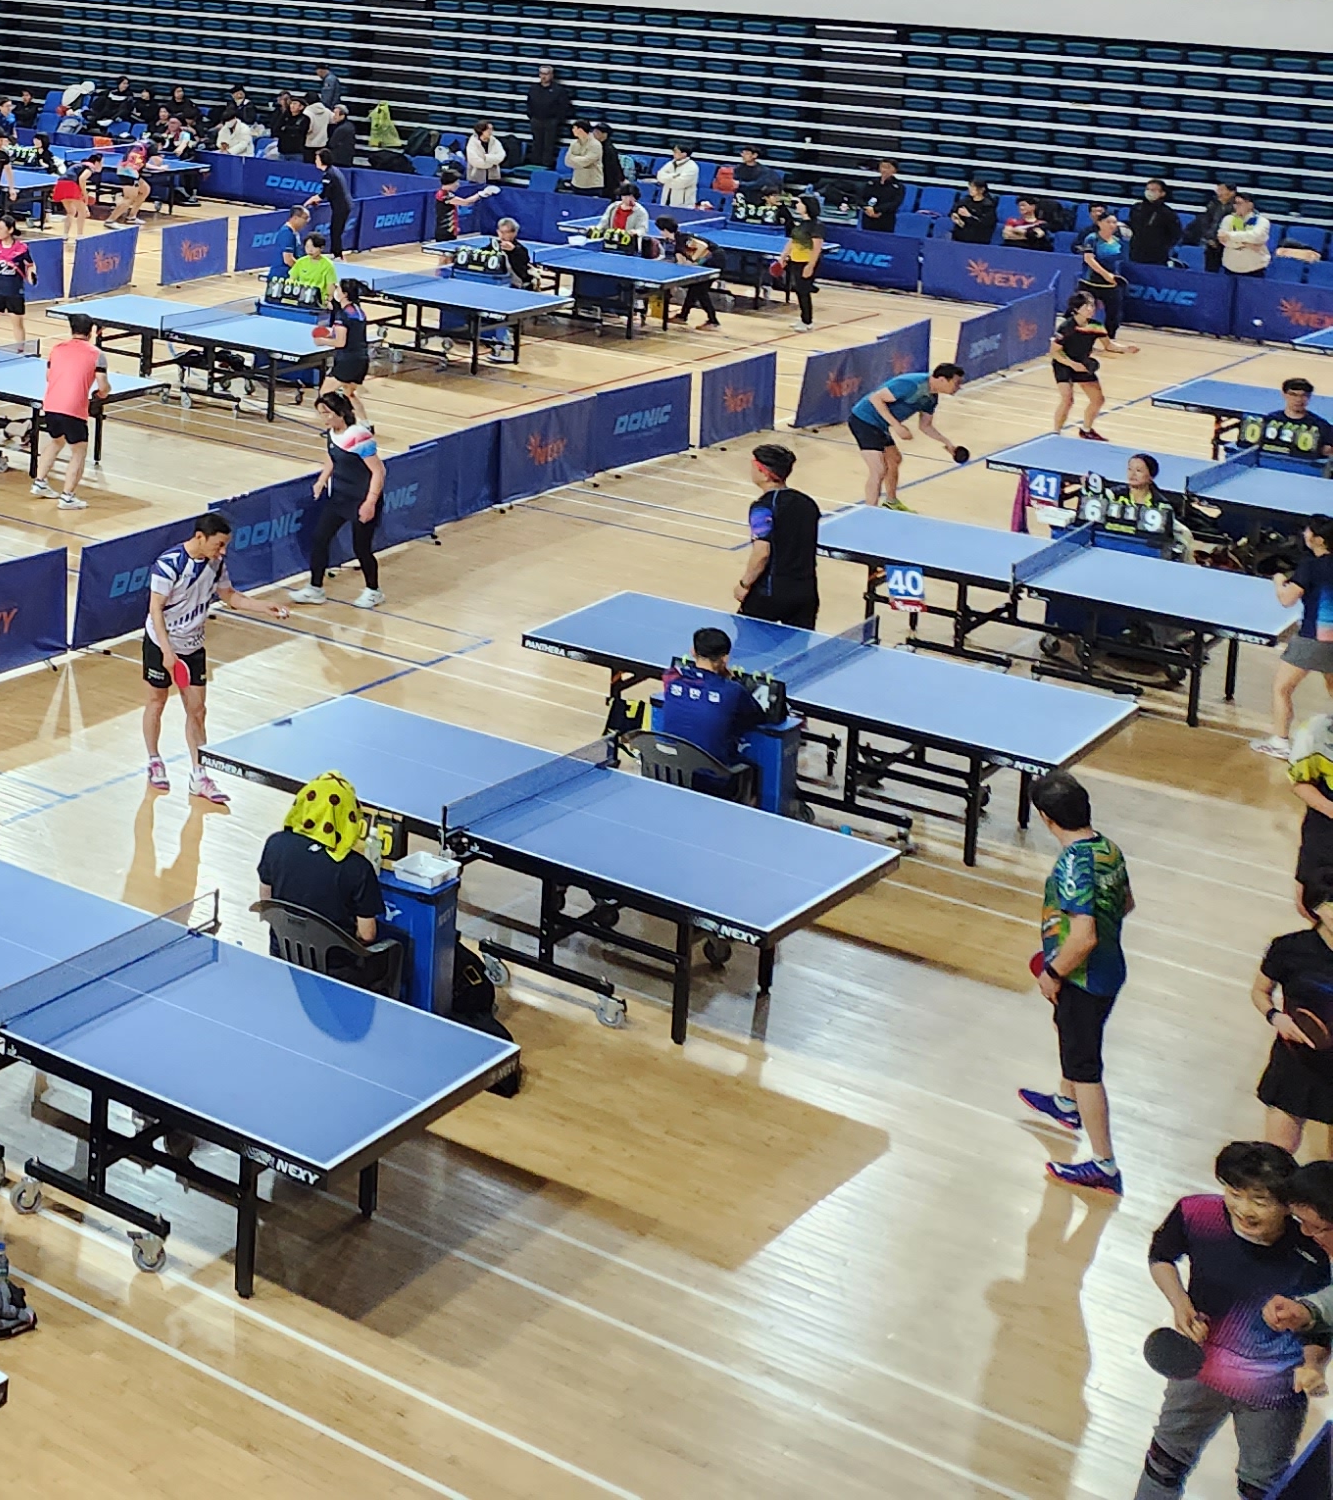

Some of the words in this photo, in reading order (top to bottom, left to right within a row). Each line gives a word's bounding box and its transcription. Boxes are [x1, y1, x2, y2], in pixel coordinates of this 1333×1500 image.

[374, 211, 415, 229] DONIC
[823, 248, 894, 268] ONIC
[977, 271, 1035, 289] NEXY
[613, 404, 672, 435] DONIC
[1028, 474, 1058, 498] 41
[234, 509, 304, 551] DONIC
[888, 569, 924, 597] 40
[201, 755, 244, 782] PANTHERA
[376, 824, 395, 858] 5
[720, 924, 762, 945] NEXY
[274, 1157, 320, 1186] NEXY
